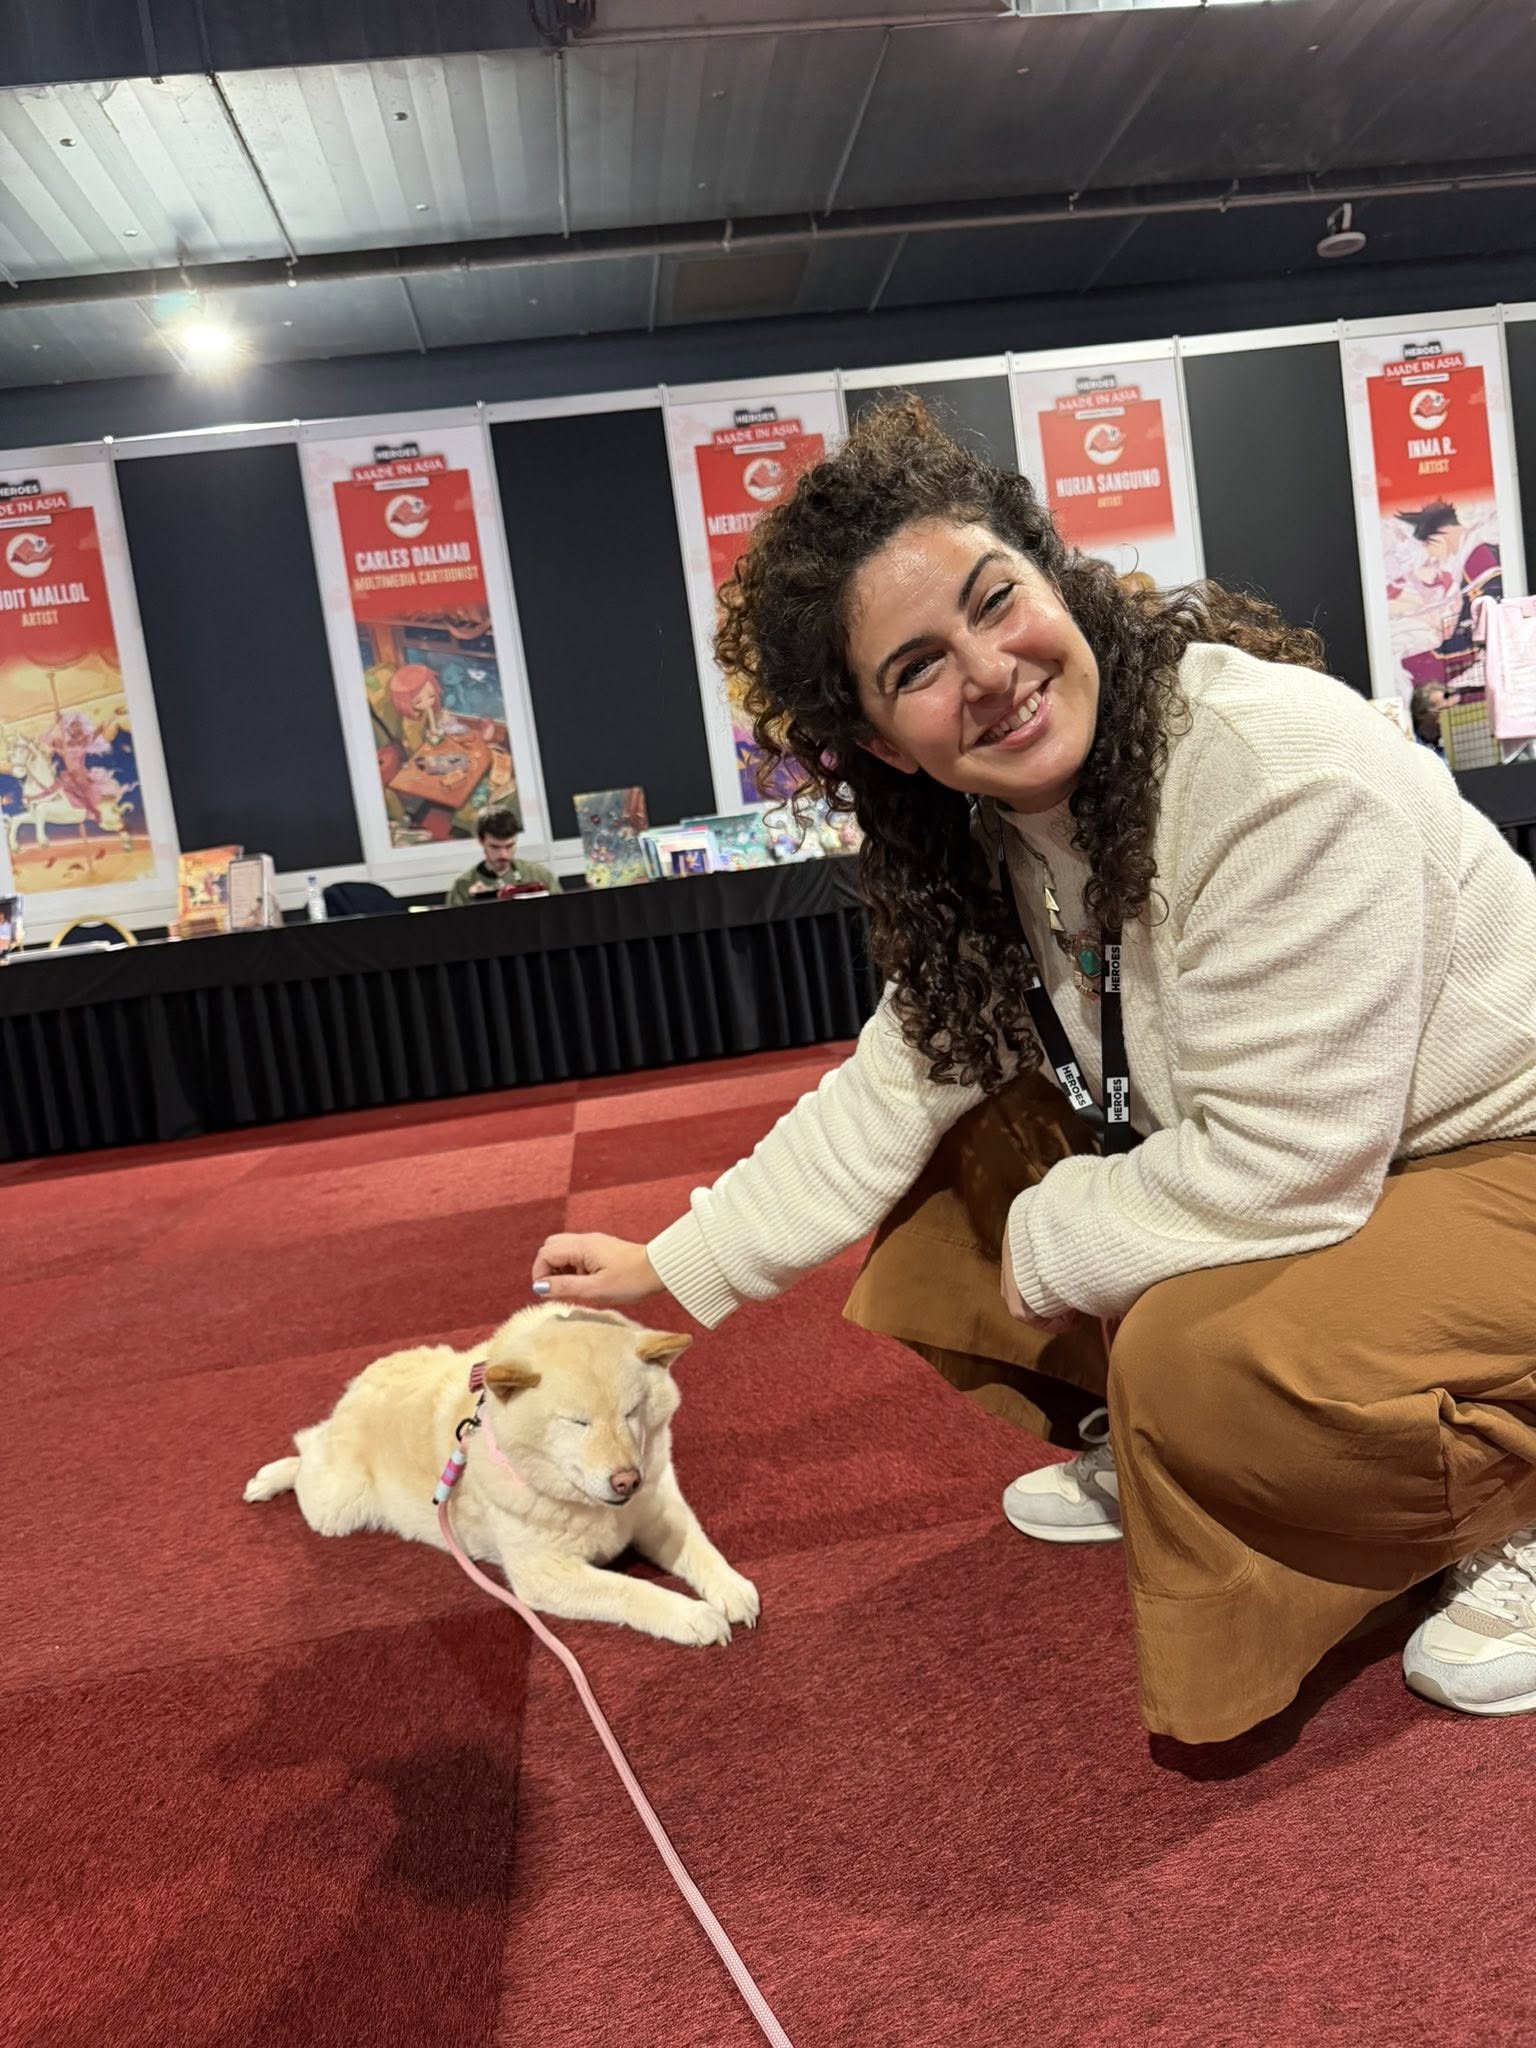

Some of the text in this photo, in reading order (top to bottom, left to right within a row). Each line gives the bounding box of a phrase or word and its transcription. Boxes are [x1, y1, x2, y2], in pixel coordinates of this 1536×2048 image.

[1404, 345, 1442, 356] HEROES
[1386, 356, 1463, 377] MADE IN ASIA
[1058, 389, 1139, 410] MADE IN ASIA
[715, 423, 801, 445] MADE IN ASIA
[1442, 435, 1457, 456] R.
[355, 458, 444, 481] MADE IN ASIA
[1418, 459, 1450, 475] ARTIST
[1055, 467, 1161, 497] NURIA SANGUINO
[17, 501, 34, 513] IN
[36, 496, 67, 511] ASIA
[354, 541, 471, 572] CARLES DALMAU
[354, 565, 479, 592] MULTIMEDIA CARTOONIST
[29, 582, 90, 607] MALLOL
[22, 610, 59, 627] ARTIST
[1111, 946, 1121, 992] HEROES
[1062, 1065, 1087, 1107] HEROES
[1113, 1078, 1122, 1121] HEROES
